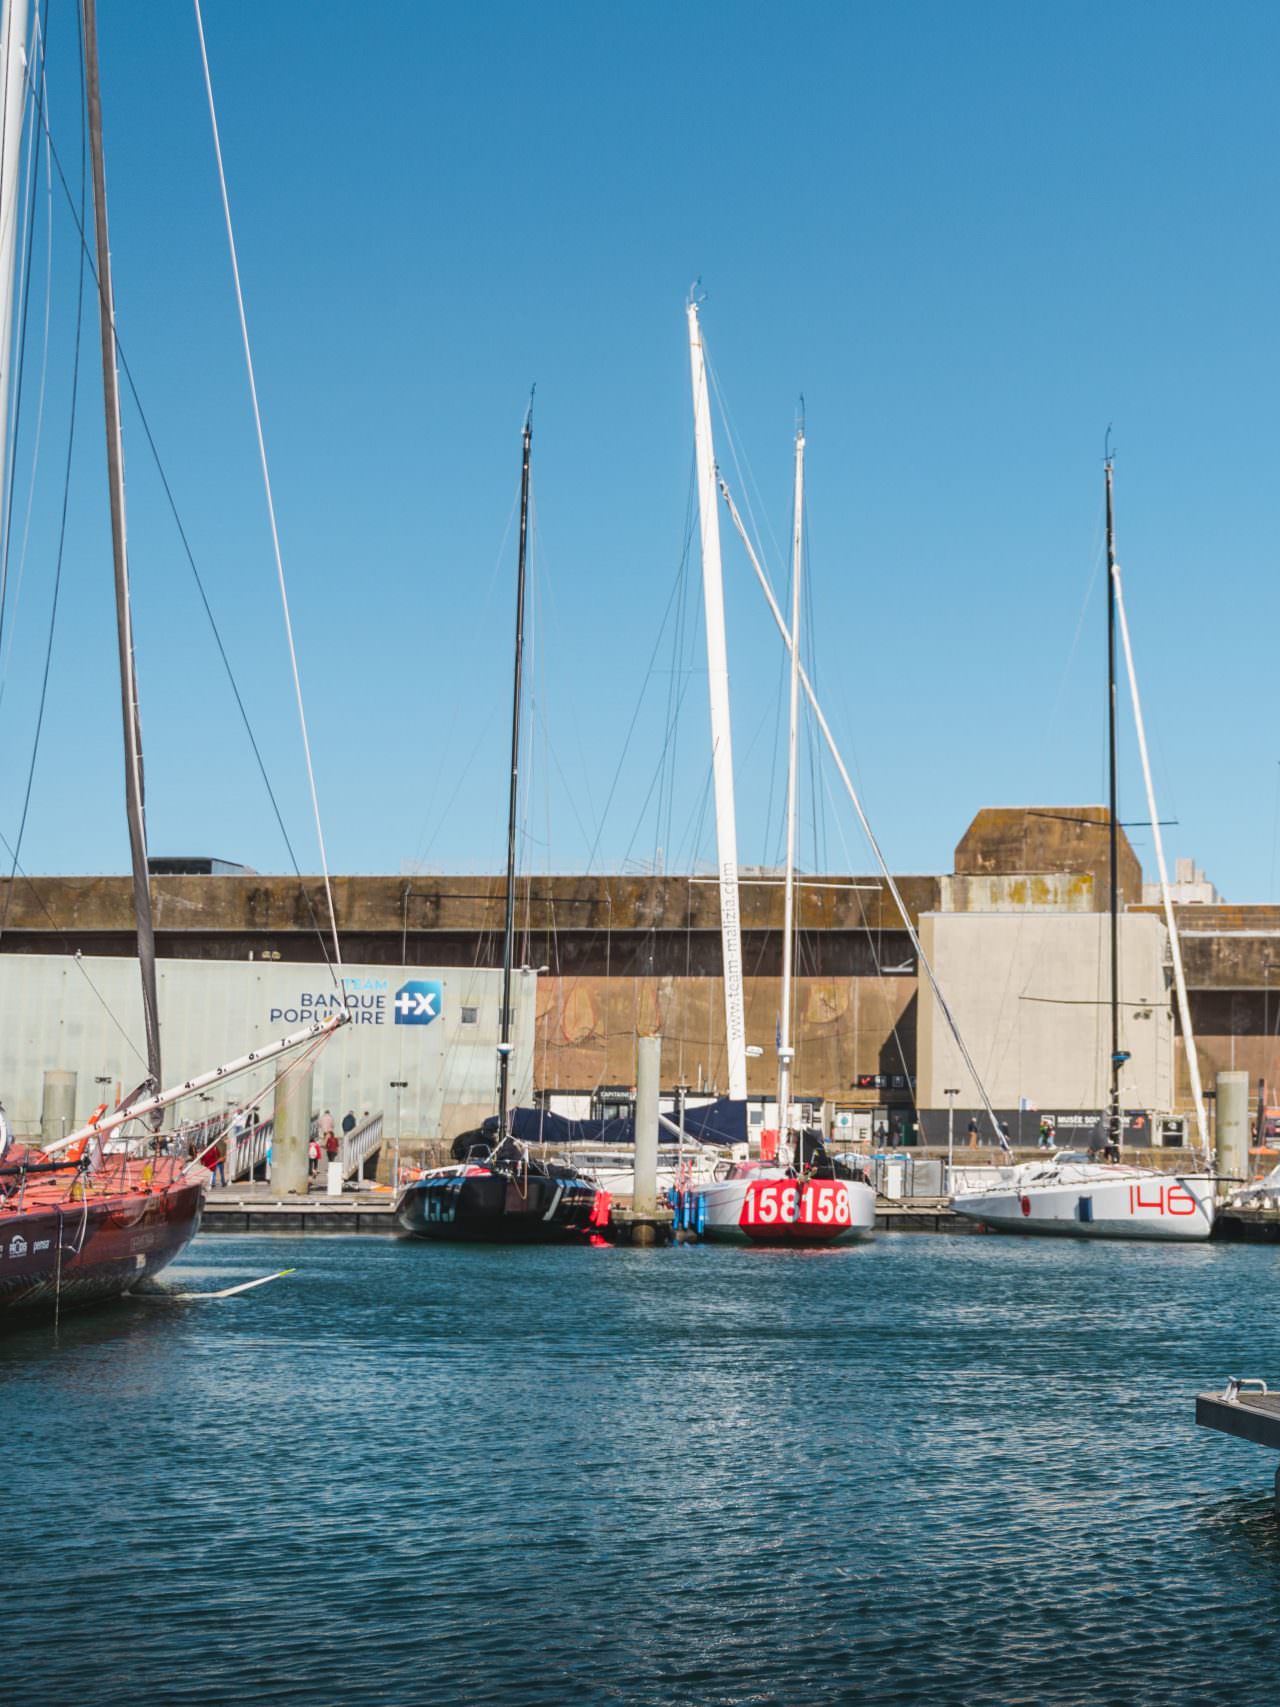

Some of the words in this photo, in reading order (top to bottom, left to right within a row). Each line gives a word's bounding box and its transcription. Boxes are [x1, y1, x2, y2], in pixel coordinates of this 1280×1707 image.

[301, 992, 387, 1009] BANQUE
[270, 1008, 385, 1025] POPUIRE
[744, 1187, 800, 1223] 158
[802, 1187, 849, 1224] 158
[1129, 1184, 1196, 1216] 146
